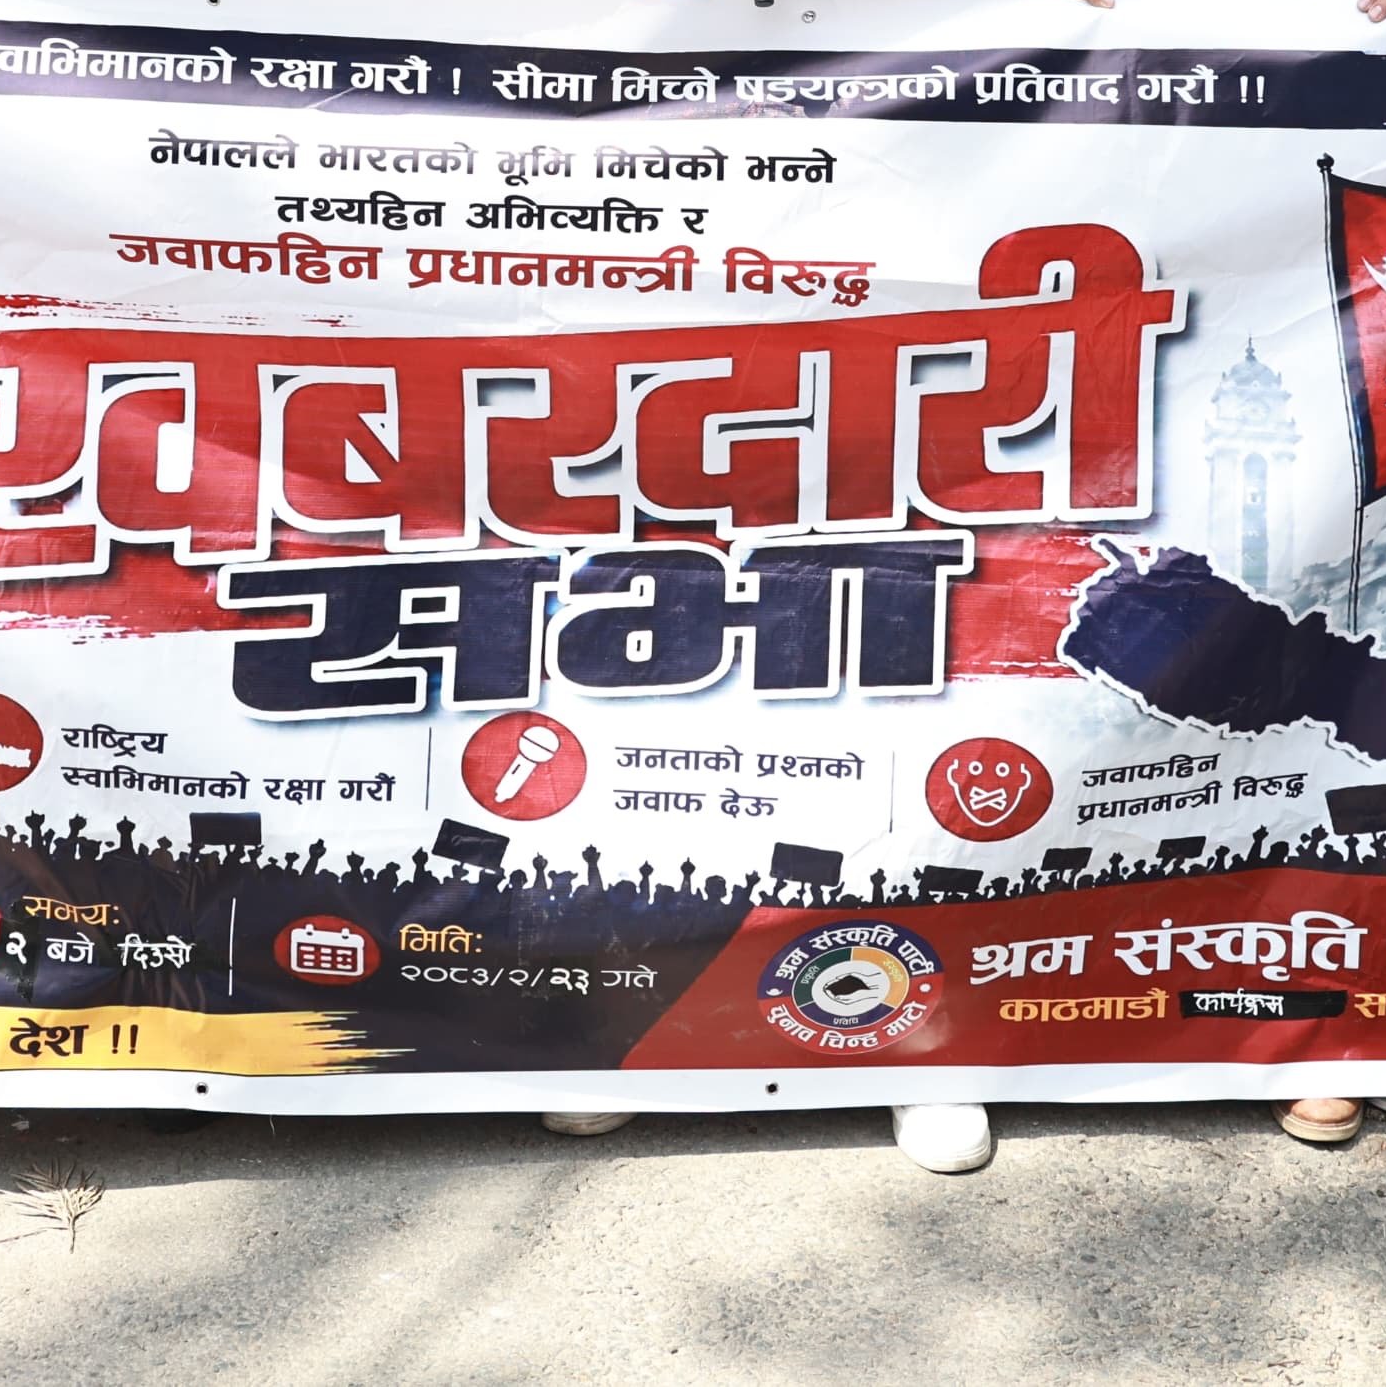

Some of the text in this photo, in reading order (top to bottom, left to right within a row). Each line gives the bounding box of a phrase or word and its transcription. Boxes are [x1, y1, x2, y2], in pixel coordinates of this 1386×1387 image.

[250, 51, 338, 90] रक्षा
[452, 66, 461, 96] !
[492, 60, 597, 105] सीमा
[612, 62, 717, 106] मिच्ने
[733, 63, 960, 106] षडयन्त्रको
[974, 62, 1122, 106] प्रतिवाद
[1237, 74, 1267, 105] !!
[149, 128, 838, 188] नेपालले भारतको भूमि मिचेको भन्ने
[275, 190, 709, 236] तथ्यहिन अभिव्यक्ति र
[109, 232, 383, 286] जवाफहिन
[407, 244, 700, 292] प्रधानमन्त्री
[217, 540, 971, 716] सभा
[62, 725, 168, 758] राष्ट्रिय
[614, 744, 866, 782] जनताको प्रश्नको
[60, 765, 248, 802] स्वाभिमानको
[264, 776, 326, 804] रक्षा
[1082, 751, 1222, 790] जवाफहिन
[613, 788, 780, 820] जवाफ देऊ
[1077, 781, 1224, 823] प्रधानमन्त्री
[6, 930, 29, 965] २
[45, 930, 96, 966] बजे
[775, 947, 810, 981] श्रम
[809, 924, 899, 952] संस्कृति
[898, 939, 935, 976] पार्टी
[968, 932, 1093, 987] श्रम
[1113, 909, 1369, 983] संस्कृति
[400, 963, 659, 996] २०८३/२/२३ गते
[9, 1016, 90, 1060] देश
[110, 1023, 140, 1055] !!
[767, 1000, 929, 1050] चुनाव चिन्ह माटो
